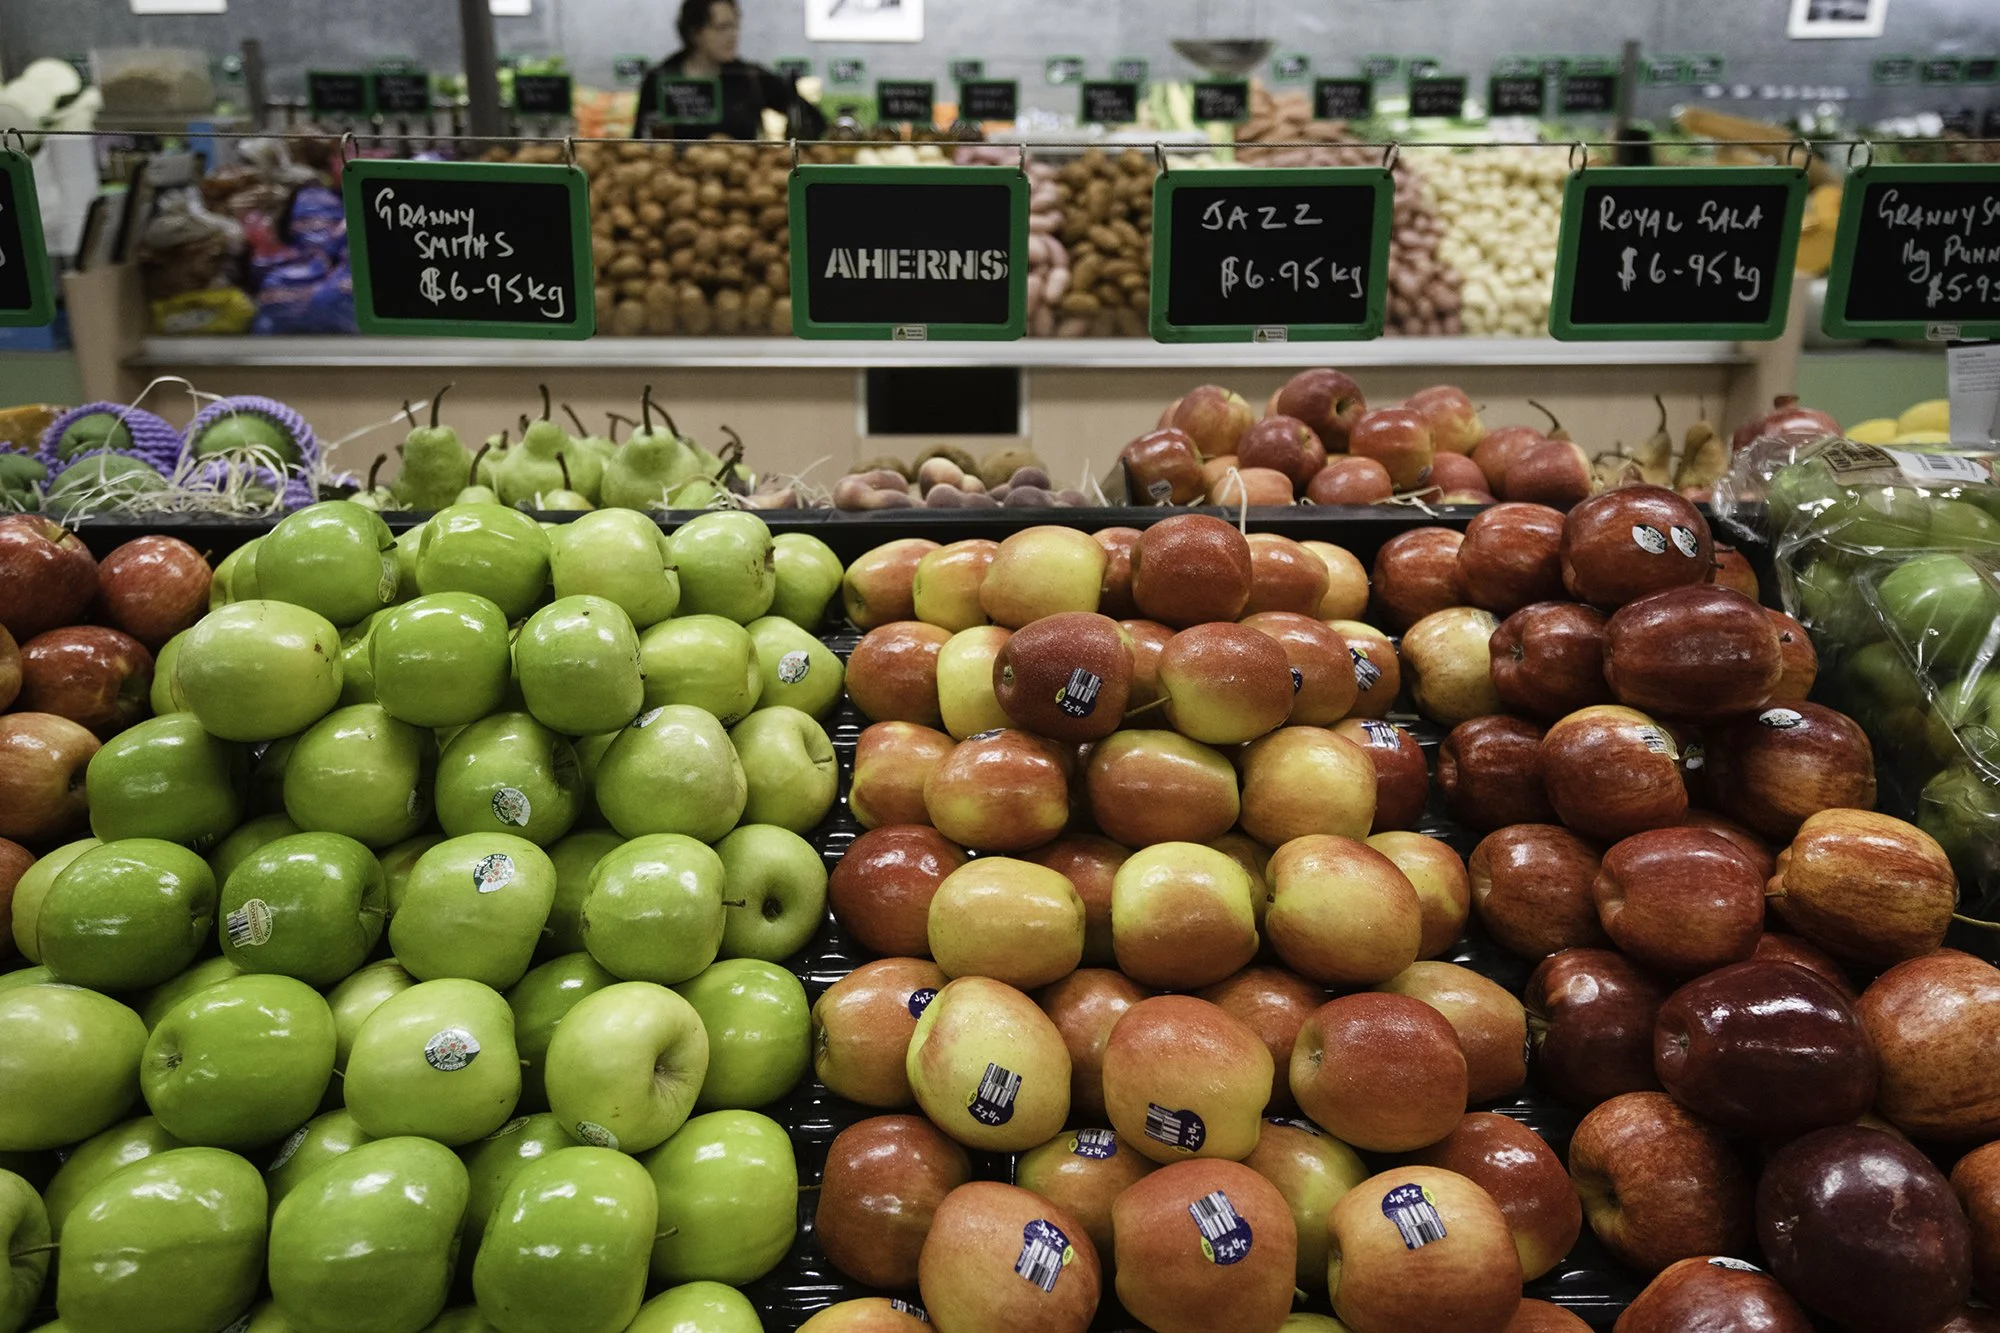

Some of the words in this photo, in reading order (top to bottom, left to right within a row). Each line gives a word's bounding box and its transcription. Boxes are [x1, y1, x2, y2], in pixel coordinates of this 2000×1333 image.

[375, 187, 475, 237] GRANNY
[1201, 200, 1323, 230] JAZZ
[1600, 195, 1683, 238] ROYAL
[1698, 200, 1763, 233] GALA
[1879, 189, 1976, 236] GRANNY
[414, 231, 515, 260] SMITHS
[824, 248, 1009, 281] AHERNS
[1063, 700, 1085, 716] JAZZ
[250, 901, 264, 944] MONTAGUE
[975, 1103, 1001, 1124] JAZZ
[1186, 1122, 1202, 1147] JAZZ
[1080, 1145, 1108, 1158] JAZZ
[1388, 1188, 1420, 1204] JAZZ
[1036, 1219, 1064, 1248] JAZZ
[1218, 1237, 1247, 1258] JAZZ
